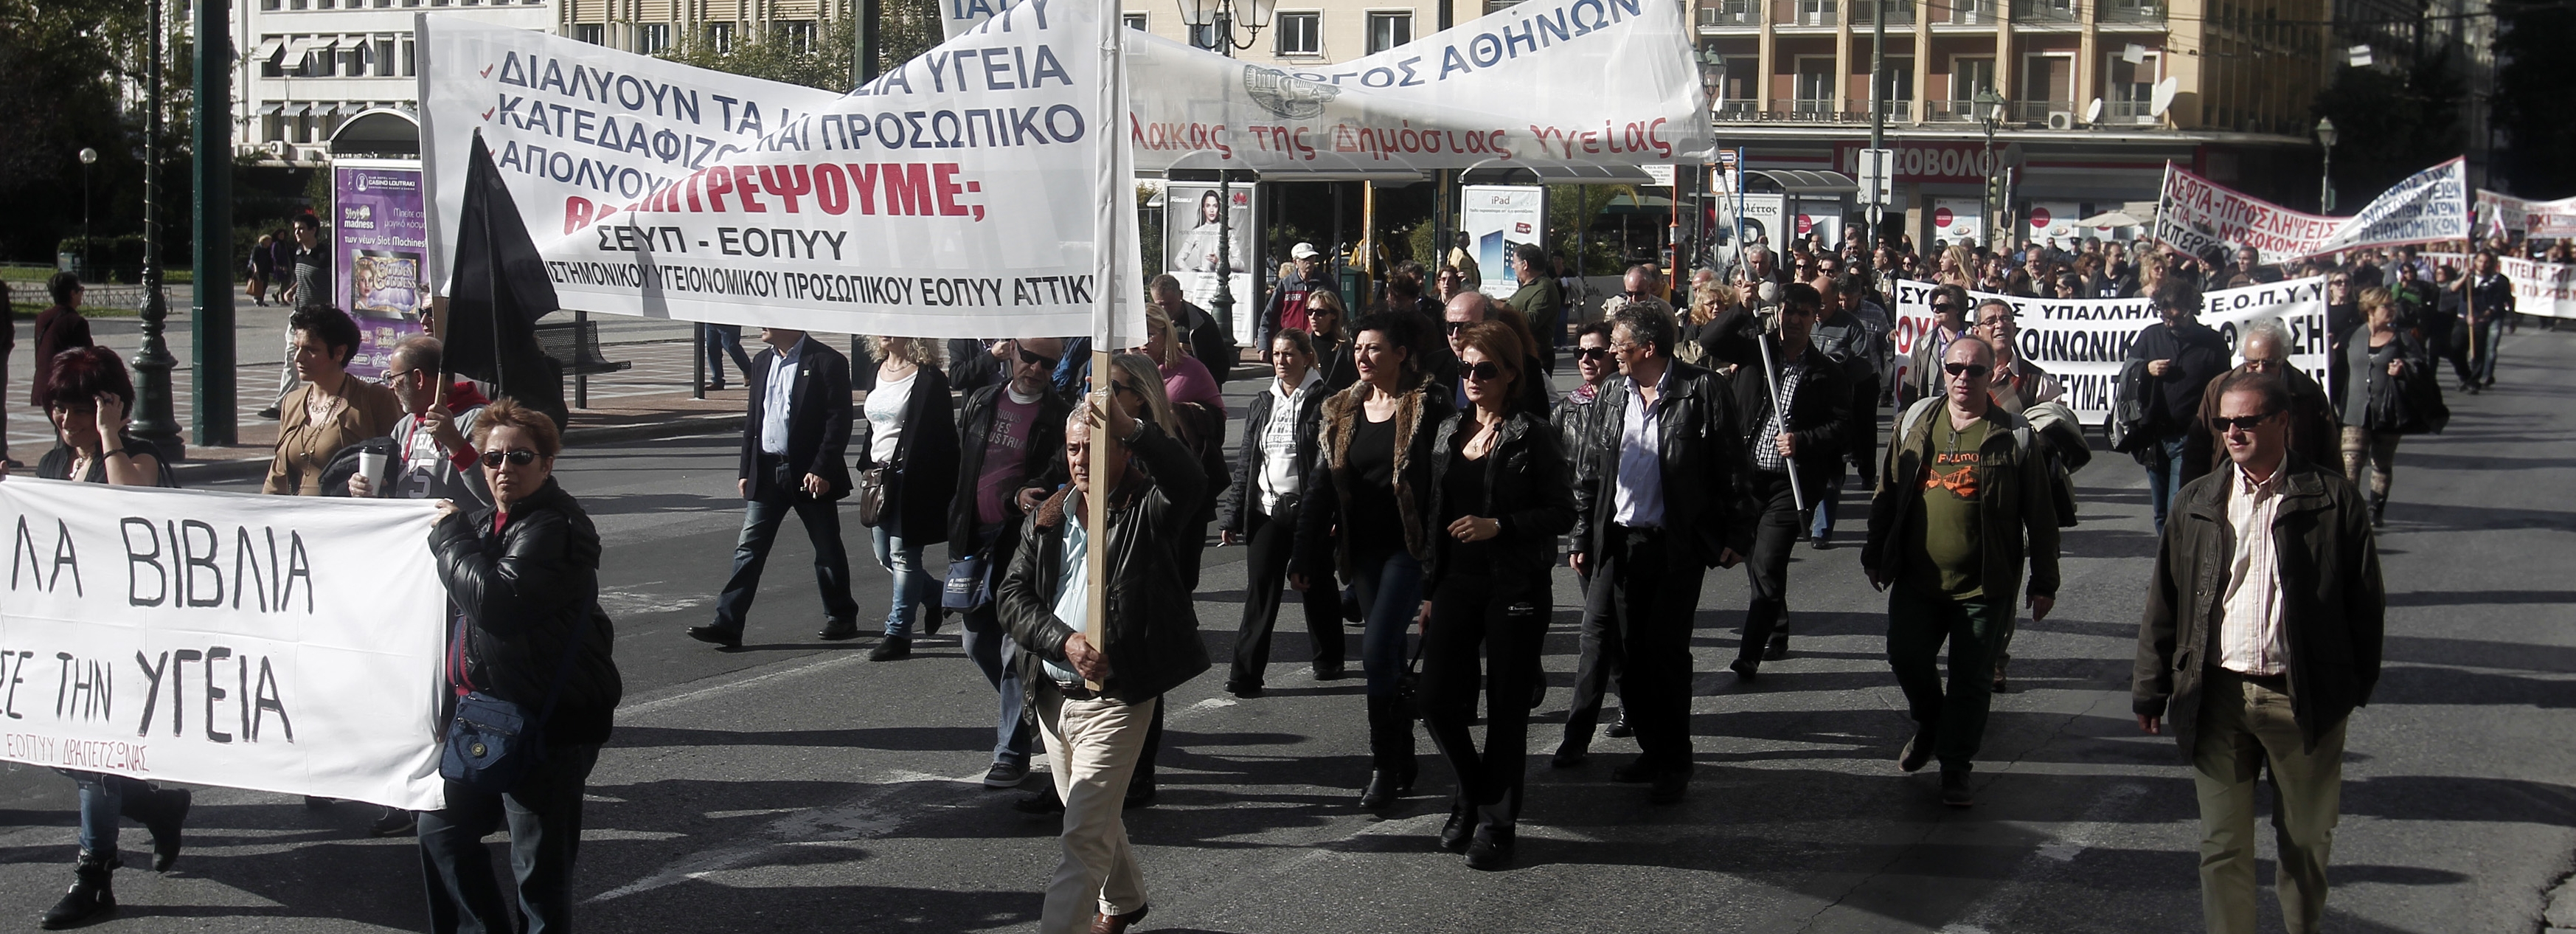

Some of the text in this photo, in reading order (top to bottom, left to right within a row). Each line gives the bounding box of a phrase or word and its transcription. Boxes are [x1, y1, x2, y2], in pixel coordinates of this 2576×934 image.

[1439, 0, 1642, 80] ΑΘΗΝΩΝ
[926, 45, 1073, 93] ΥΓΕΙΑ
[499, 51, 763, 139] ΔΙΑΛΥΟΥΝ ΤΑ
[821, 104, 1085, 151] ΠΡΟΣΩΠΙΚΟ
[1249, 125, 1316, 160] της
[1336, 120, 1512, 160] Δημόσιας
[1530, 117, 1672, 159] Υγείας
[499, 140, 673, 199] ΑΠΟΛΥΟΥ
[1844, 147, 2007, 177] ΚΣΟΒΟΛΟΣ
[1491, 196, 1510, 204] iPad
[1723, 203, 1777, 215] γλέττος
[344, 218, 375, 229] madness
[344, 236, 357, 244] των
[377, 235, 391, 246] Slot
[598, 225, 687, 252] ΣΕΥΠ
[718, 227, 847, 260] ΕΟΠΥΥ
[653, 264, 778, 299] ΥΓΕΙΟΝΟΜΙΚΟΥ
[783, 273, 913, 305] ΠΡΟΣΩΠΙΚΟΥ
[921, 277, 1002, 307] ΕΟΠΥΥ
[1014, 274, 1094, 305] ΑΤΤΙΚ
[2041, 305, 2159, 320] ΥΠΑΛΛΗΛ
[2013, 325, 2142, 362] ΟΙΝΩΝΙΚ
[119, 516, 314, 615] ΒΙΒΛΙΑ
[56, 651, 111, 725] ΤΗΝ
[136, 646, 296, 744] ΥΓΕΙΑ
[7, 733, 150, 772] ΕΟΠΥΥ ΔΡΑΠΕΤΣΩΝΑΣ
